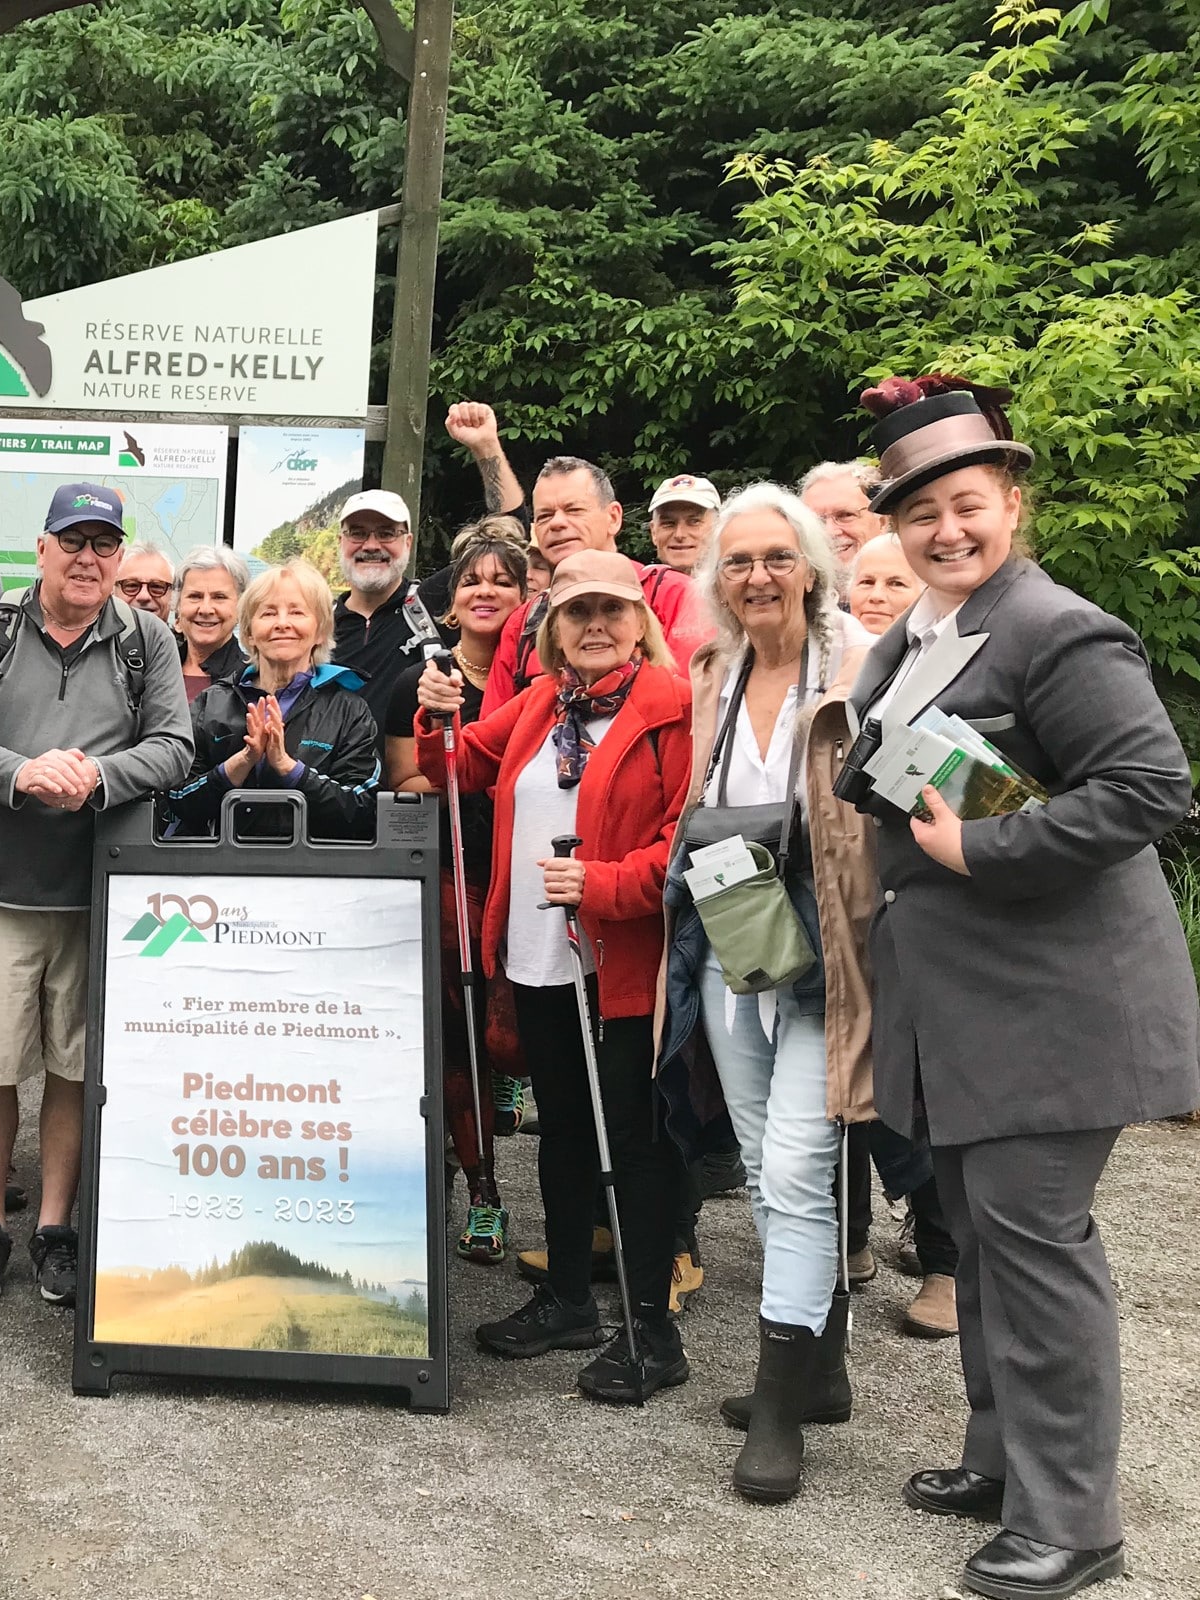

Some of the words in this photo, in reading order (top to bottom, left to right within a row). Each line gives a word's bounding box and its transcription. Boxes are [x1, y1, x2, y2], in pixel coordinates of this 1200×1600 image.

[85, 318, 185, 342] RÉSERVE
[194, 325, 323, 346] NATURELLE
[83, 348, 325, 381] ALFRED-KELLY
[83, 381, 162, 399] NATURE
[171, 384, 257, 402] RESERVE
[41, 438, 74, 451] TRAIL
[77, 440, 105, 452] MAP
[153, 455, 216, 463] ALFRED-KELLY
[286, 458, 318, 472] CRPF
[220, 905, 250, 921] ans
[182, 996, 224, 1012] Fier
[228, 998, 310, 1014] membre
[315, 1000, 339, 1015] de
[343, 1001, 362, 1016] la
[124, 1018, 248, 1037] municipalité
[253, 1021, 277, 1037] de
[282, 1022, 380, 1039] Piedmont
[182, 1072, 342, 1104] Piedmont
[171, 1108, 293, 1140] célèbre
[300, 1119, 353, 1142] ses
[172, 1143, 246, 1178] 100
[257, 1154, 327, 1182] ans
[168, 1193, 245, 1219] 1923
[273, 1196, 356, 1224] 2023
